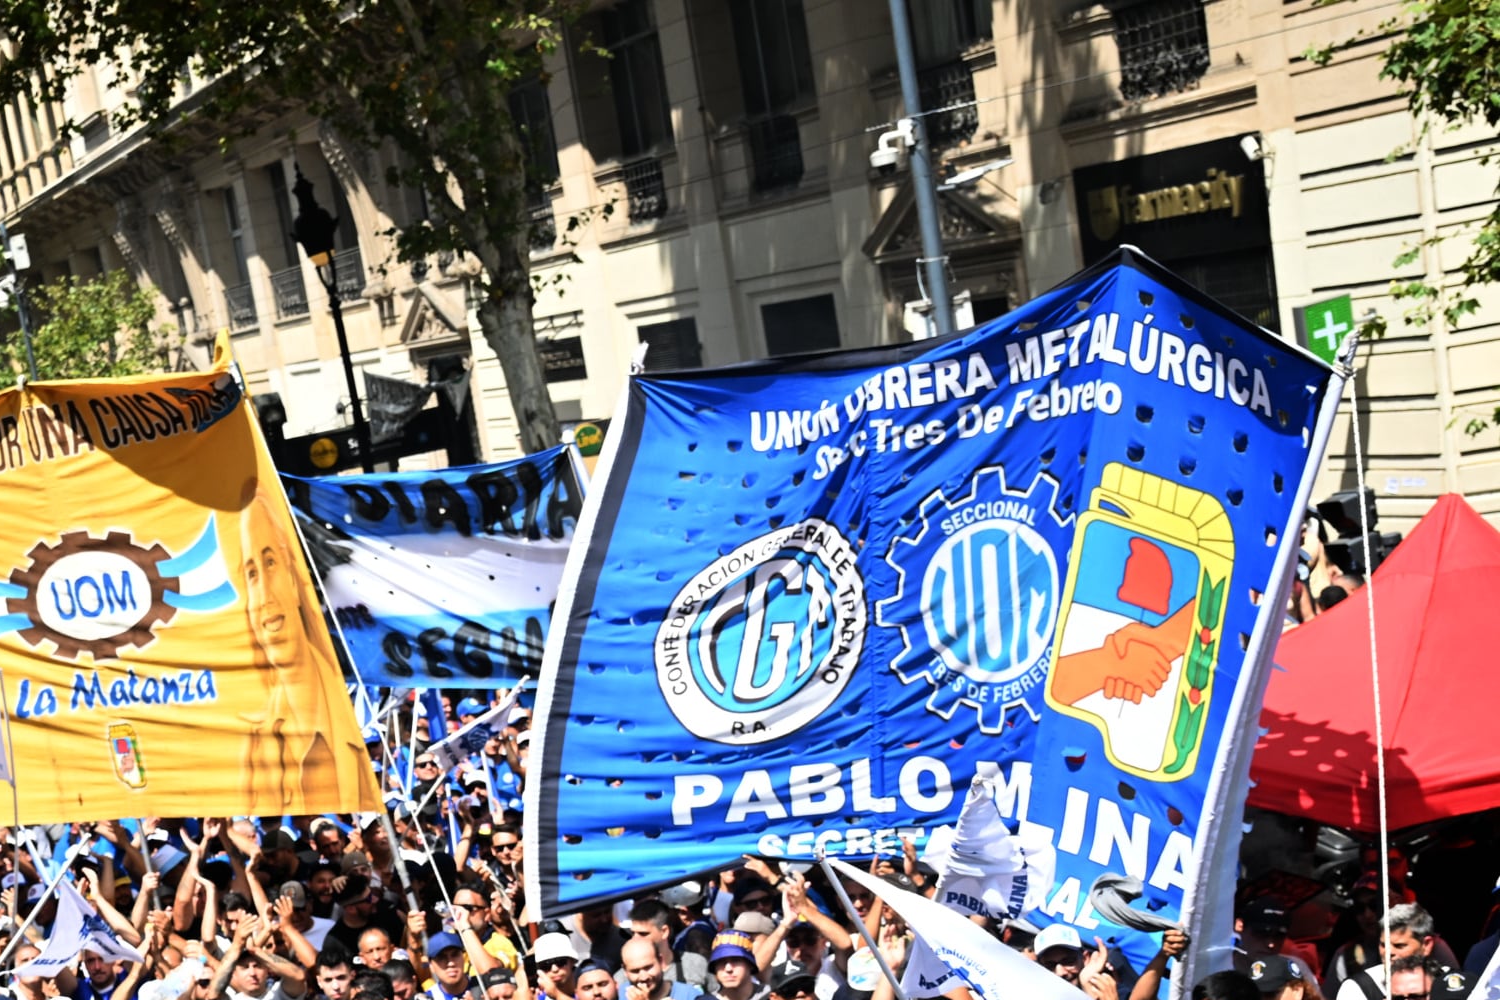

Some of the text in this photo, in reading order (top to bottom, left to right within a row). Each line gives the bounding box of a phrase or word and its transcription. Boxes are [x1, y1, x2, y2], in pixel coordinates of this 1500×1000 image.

[1004, 312, 1274, 418] METALÚRGICA
[21, 401, 94, 465] UNA
[97, 391, 186, 450] CAUSA
[958, 403, 1003, 441] De
[1004, 375, 1124, 430] Febrero
[940, 500, 1036, 536] SECCIONAL
[51, 569, 137, 620] UOM
[70, 668, 217, 712] Matanza
[966, 684, 989, 703] DE
[671, 755, 955, 826] PABLO
